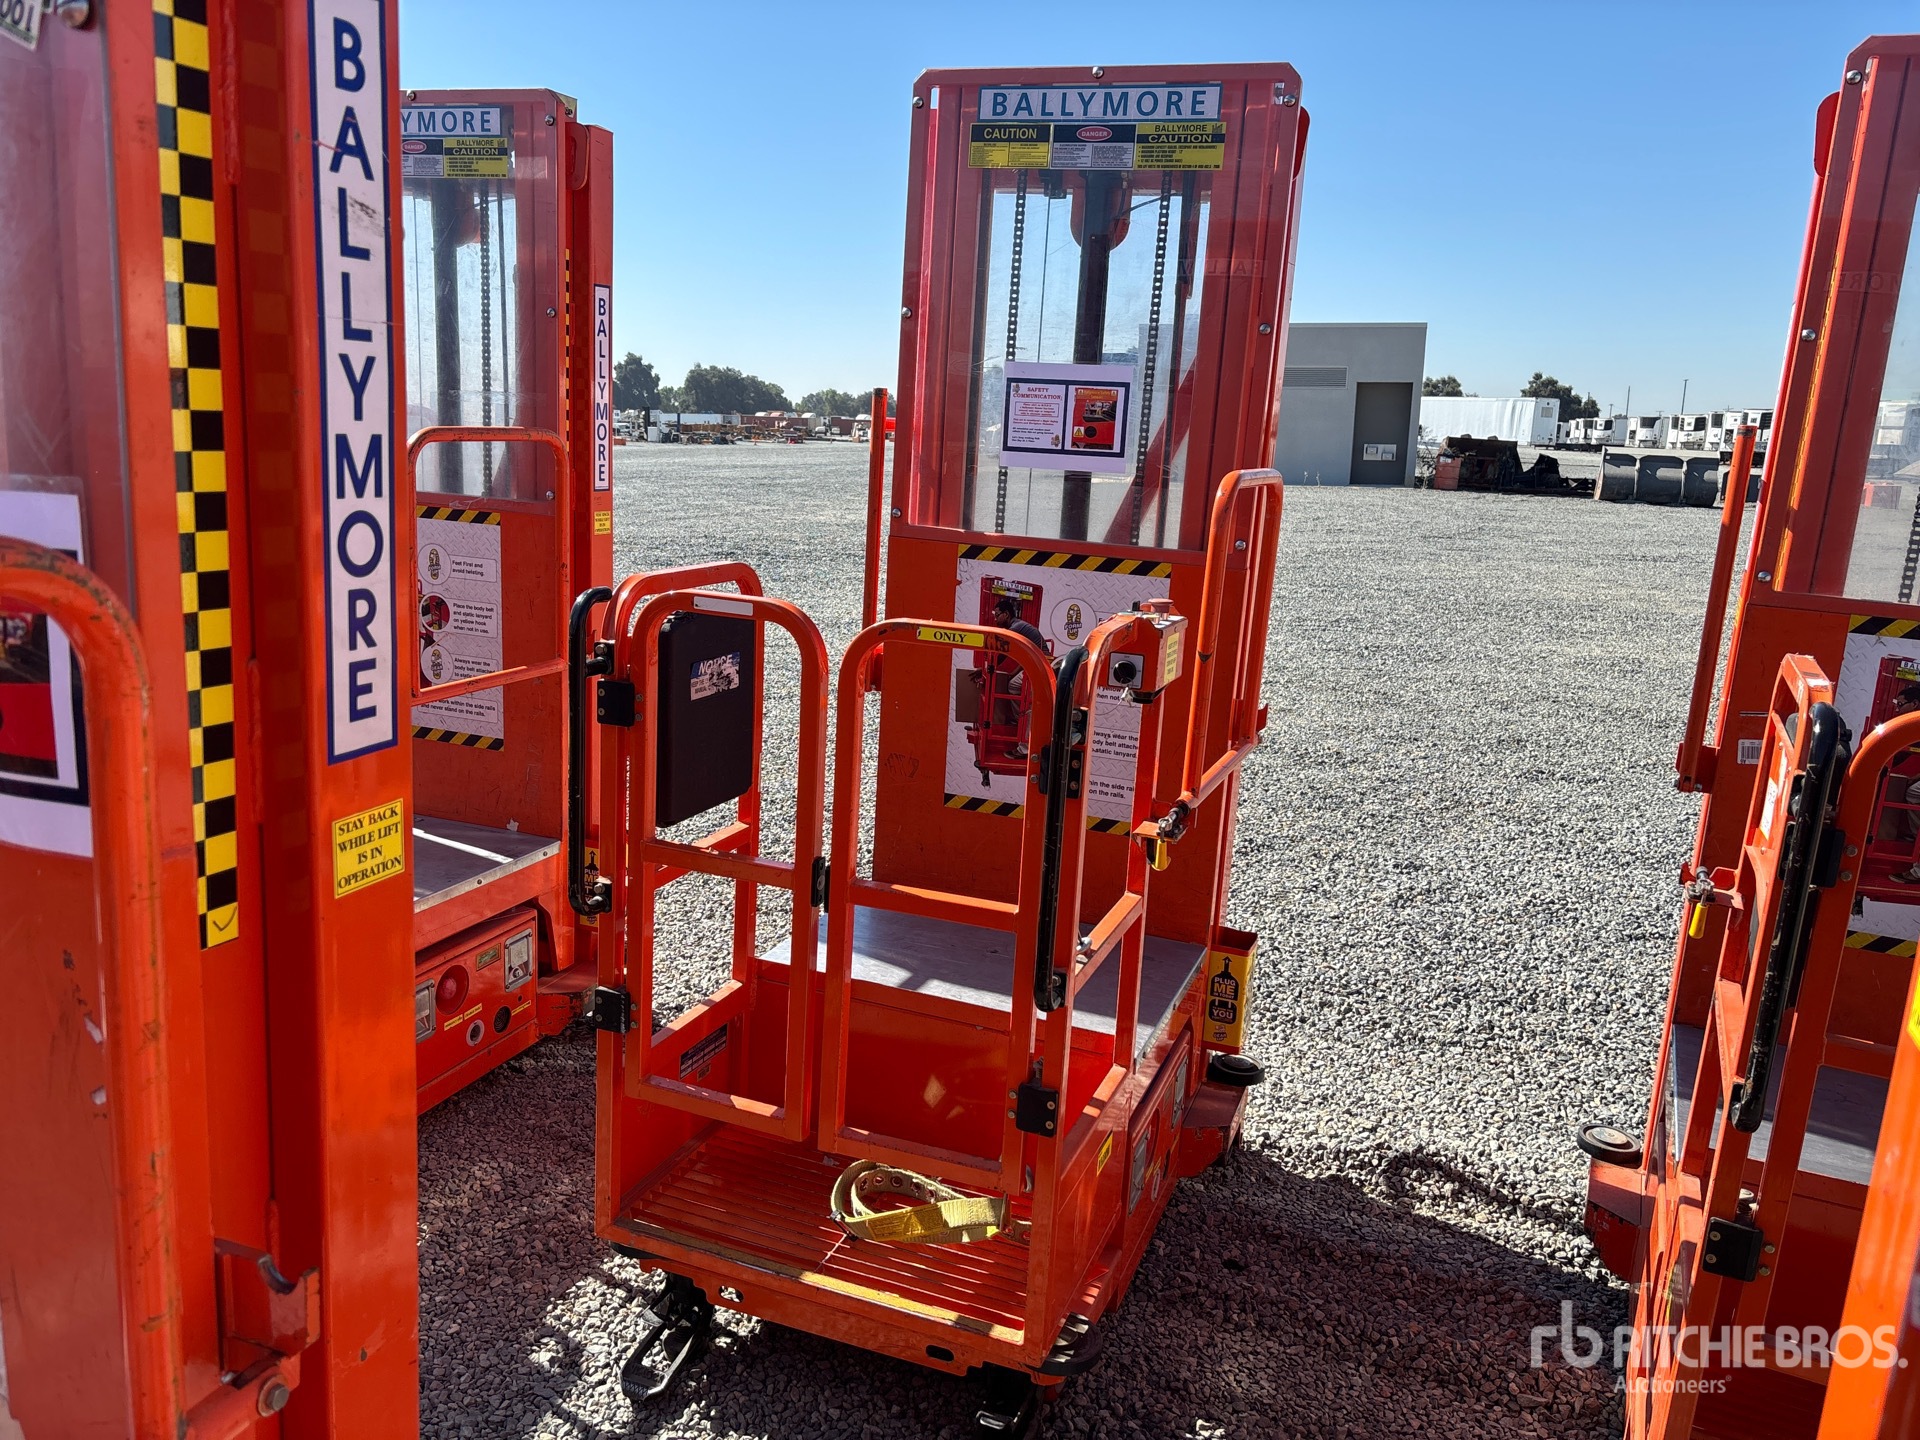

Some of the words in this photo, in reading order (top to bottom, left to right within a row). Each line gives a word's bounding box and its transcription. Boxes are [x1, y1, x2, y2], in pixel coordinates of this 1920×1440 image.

[991, 90, 1207, 117] BALLYMORE
[983, 128, 1037, 139] CAUTION
[1154, 124, 1207, 132] BALLYMORE
[1148, 134, 1212, 143] CAUTION
[329, 17, 384, 723] BALLYMORE
[596, 297, 608, 482] BALLYMORE
[933, 631, 967, 643] ONLY
[1128, 734, 1138, 742] the
[338, 817, 365, 836] STAY
[368, 805, 398, 825] BACK
[338, 830, 375, 853] WHILE
[377, 821, 400, 839] LIFT
[357, 851, 367, 864] IS
[370, 845, 383, 859] IN
[338, 855, 402, 888] OPERATION
[1214, 977, 1236, 986] PLUG
[1213, 983, 1235, 996] ME
[1212, 1009, 1233, 1019] YOU
